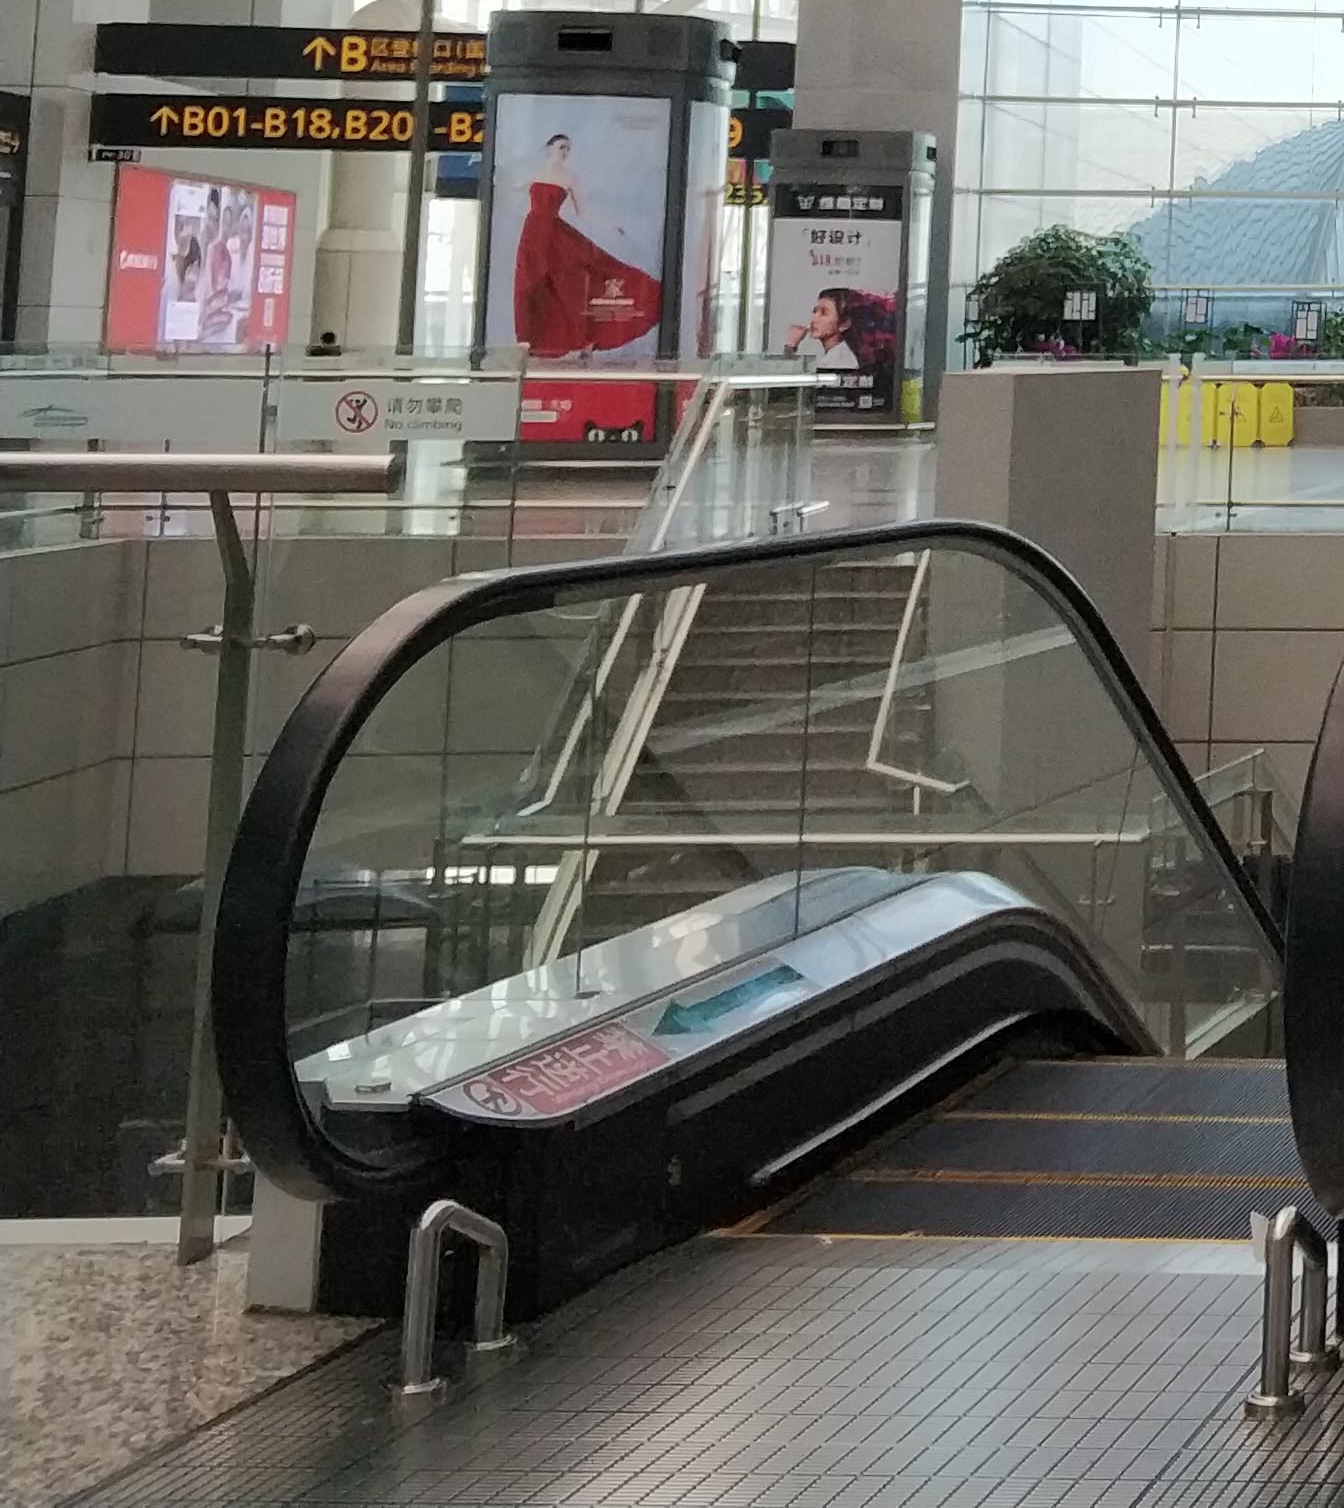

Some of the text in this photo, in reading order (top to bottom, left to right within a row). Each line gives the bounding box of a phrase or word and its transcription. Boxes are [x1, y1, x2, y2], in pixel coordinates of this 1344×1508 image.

[340, 35, 368, 72] B
[385, 419, 462, 433] No climbing
